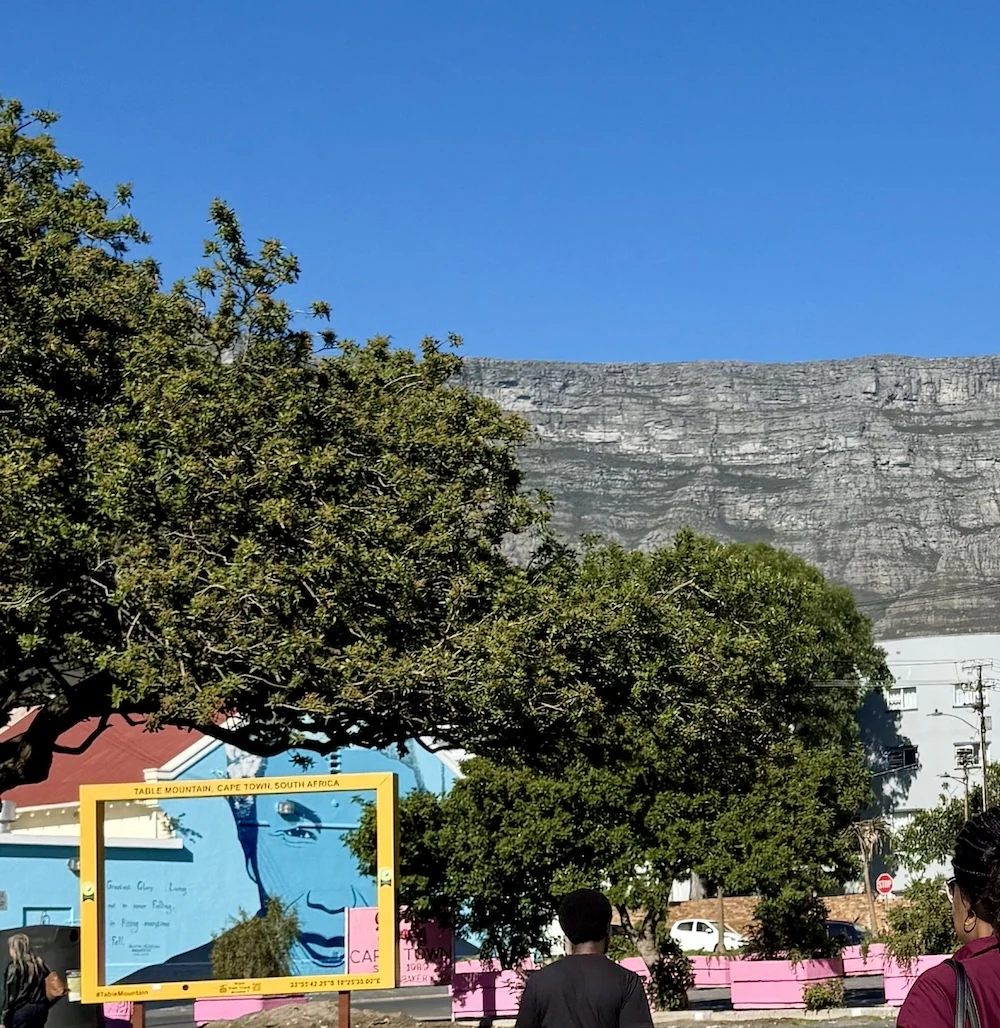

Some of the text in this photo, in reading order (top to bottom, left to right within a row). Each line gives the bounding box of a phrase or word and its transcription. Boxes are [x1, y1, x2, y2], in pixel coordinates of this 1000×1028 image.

[134, 779, 340, 795] TABLE MOUNTAIN, CAPE TOWN, SOUTH AFRICA
[350, 949, 379, 964] CAP
